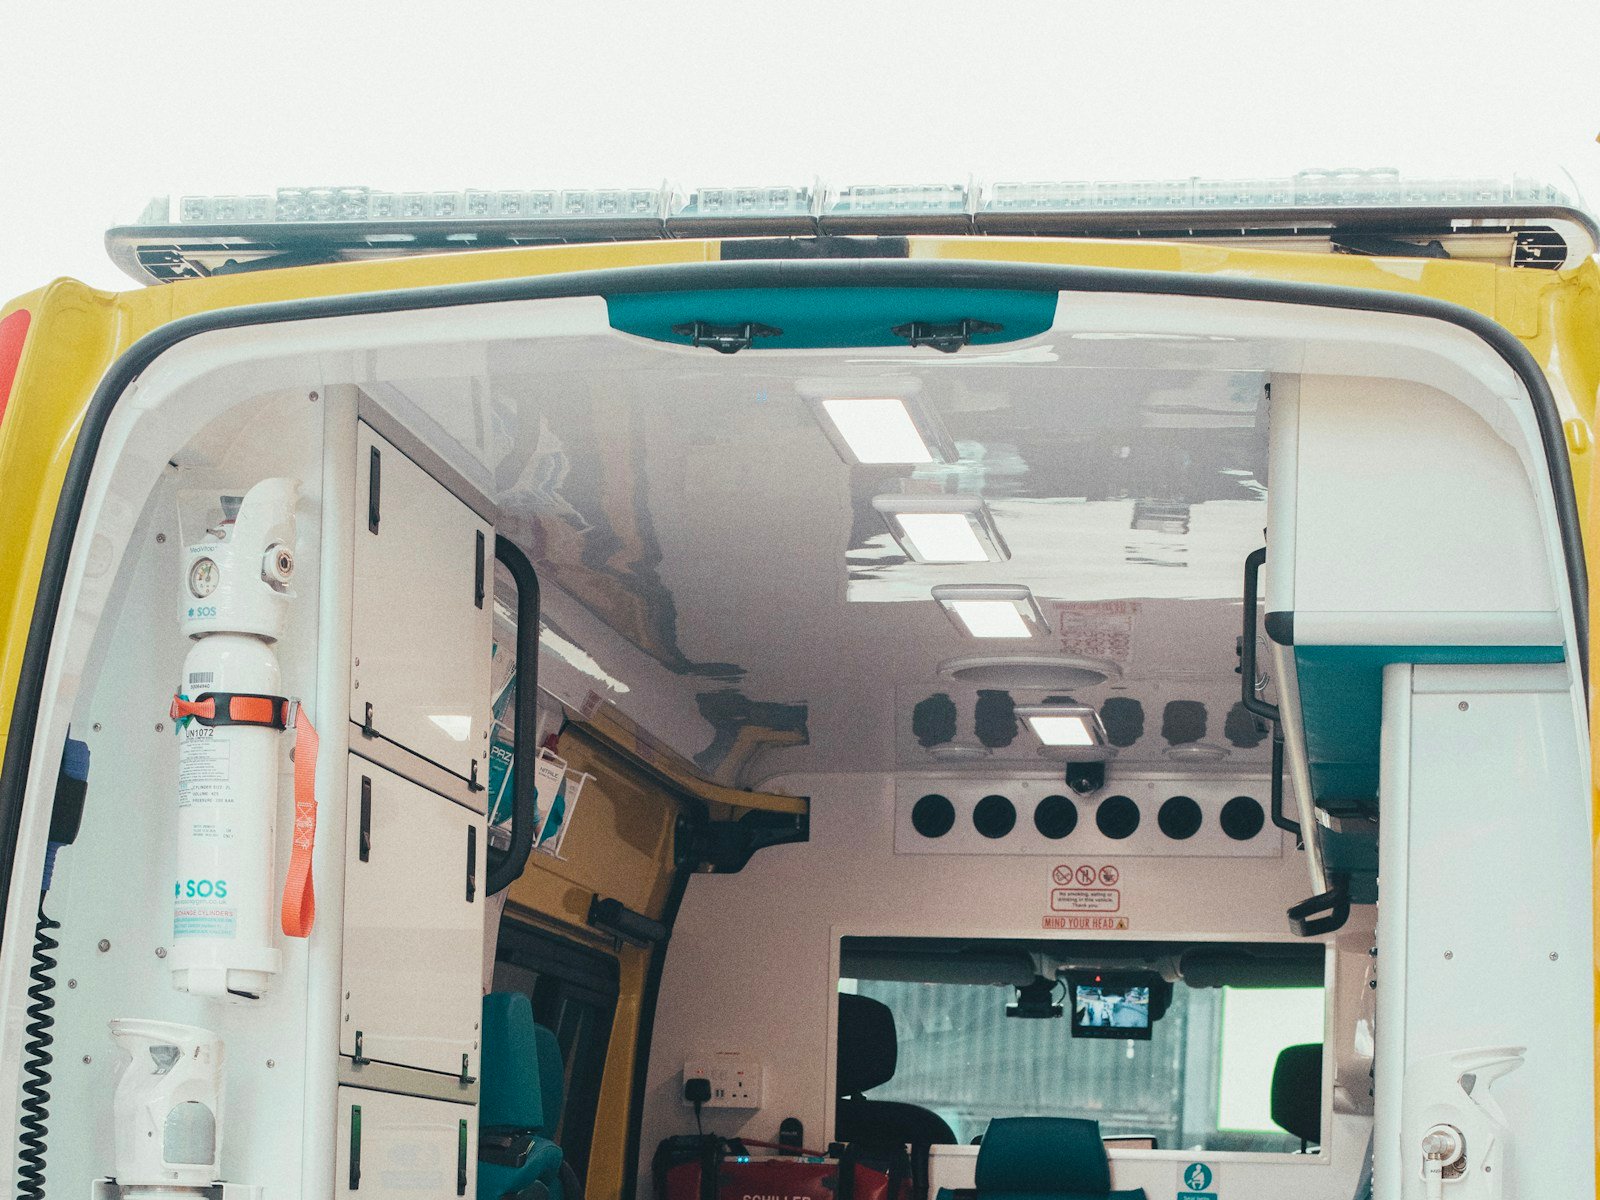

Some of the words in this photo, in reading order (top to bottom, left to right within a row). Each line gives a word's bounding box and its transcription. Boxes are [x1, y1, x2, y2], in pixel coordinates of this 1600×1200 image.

[197, 606, 217, 617] SOS
[186, 879, 227, 898] SOS
[1044, 917, 1066, 927] MIND
[1068, 918, 1090, 928] YOUR
[1092, 918, 1114, 928] HEAD
